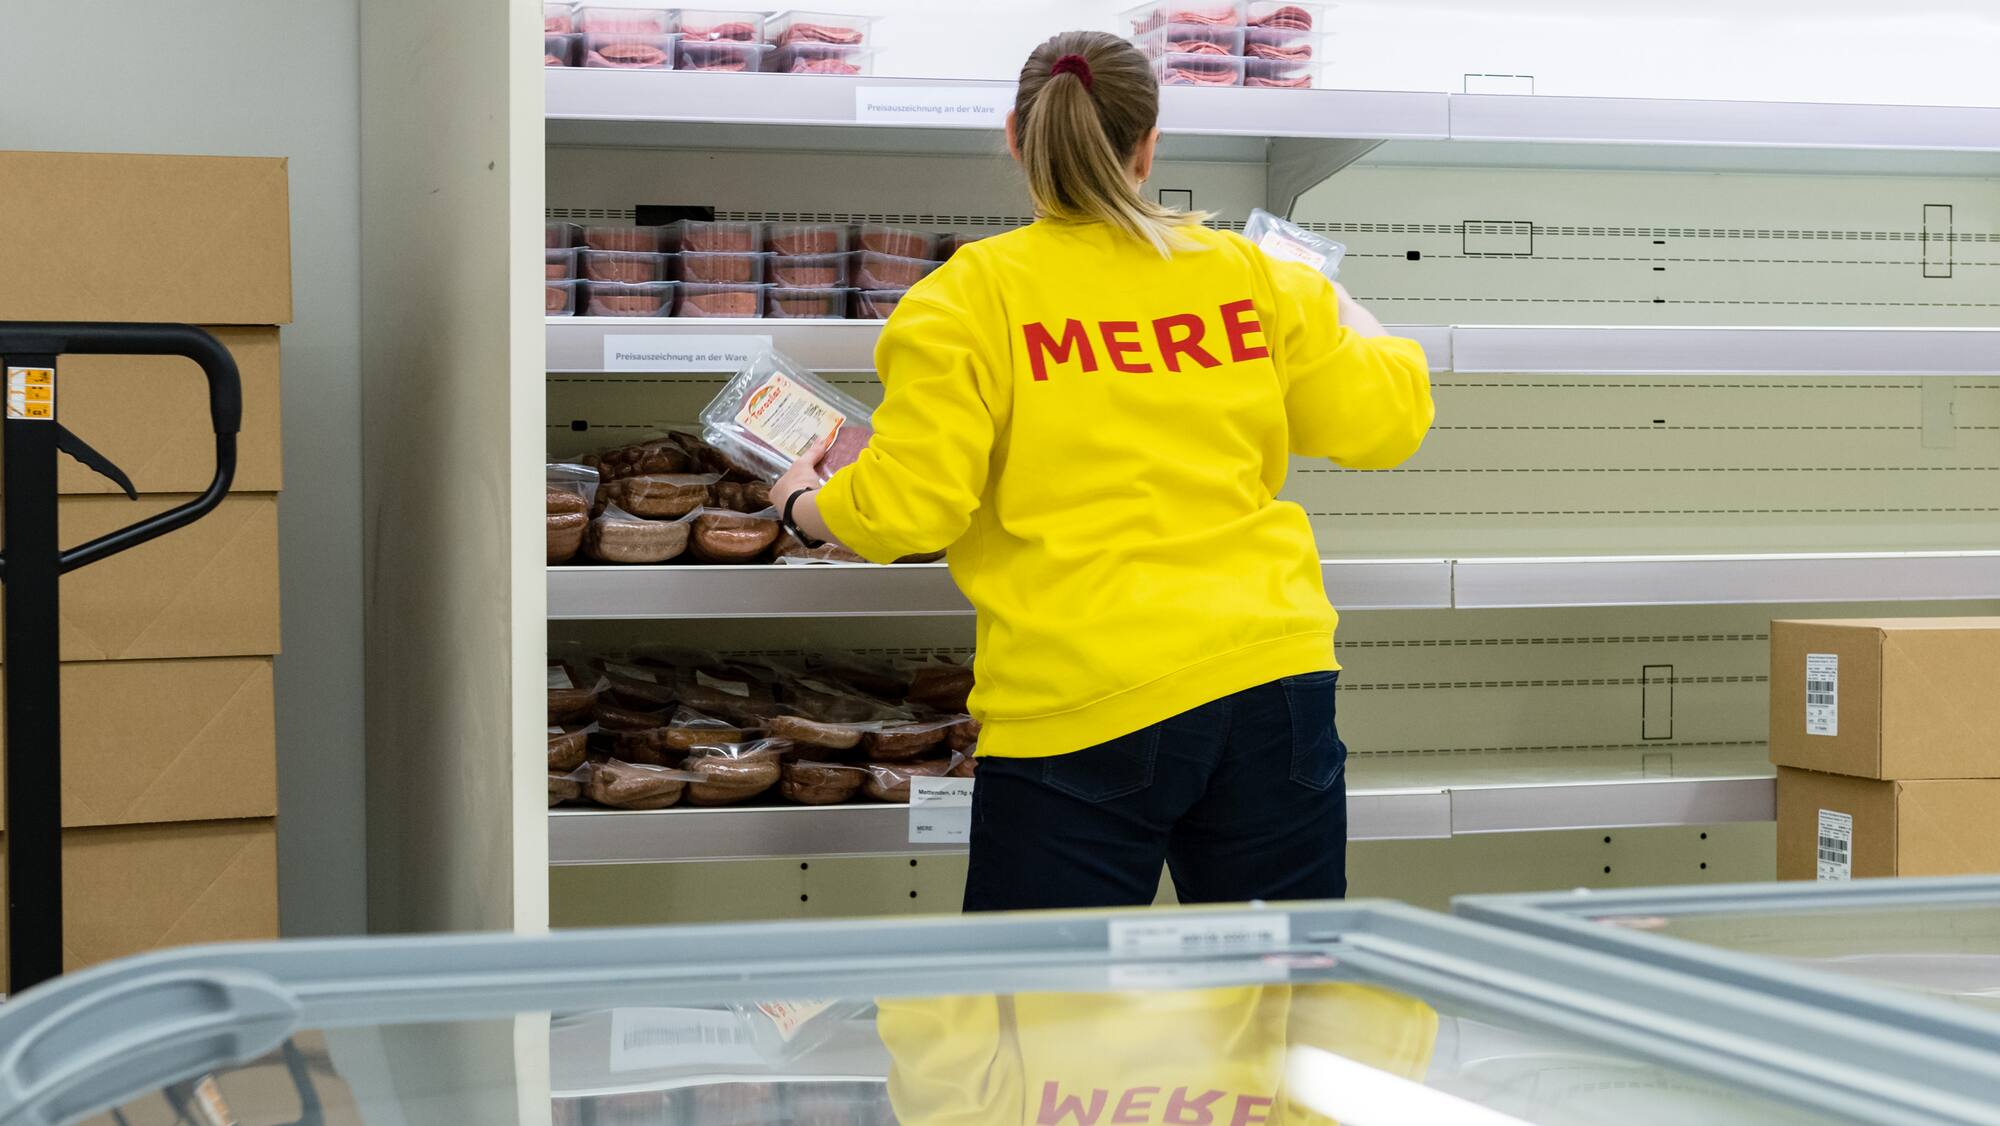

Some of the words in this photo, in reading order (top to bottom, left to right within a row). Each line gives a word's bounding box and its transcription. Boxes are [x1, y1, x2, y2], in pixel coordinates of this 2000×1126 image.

[867, 103, 943, 114] Preisauszeichnung
[956, 104, 971, 113] der
[973, 105, 995, 114] Ware
[1022, 299, 1270, 382] MERE
[615, 352, 693, 363] Preisauszeichnung
[708, 353, 722, 362] der
[724, 353, 748, 362] Ware
